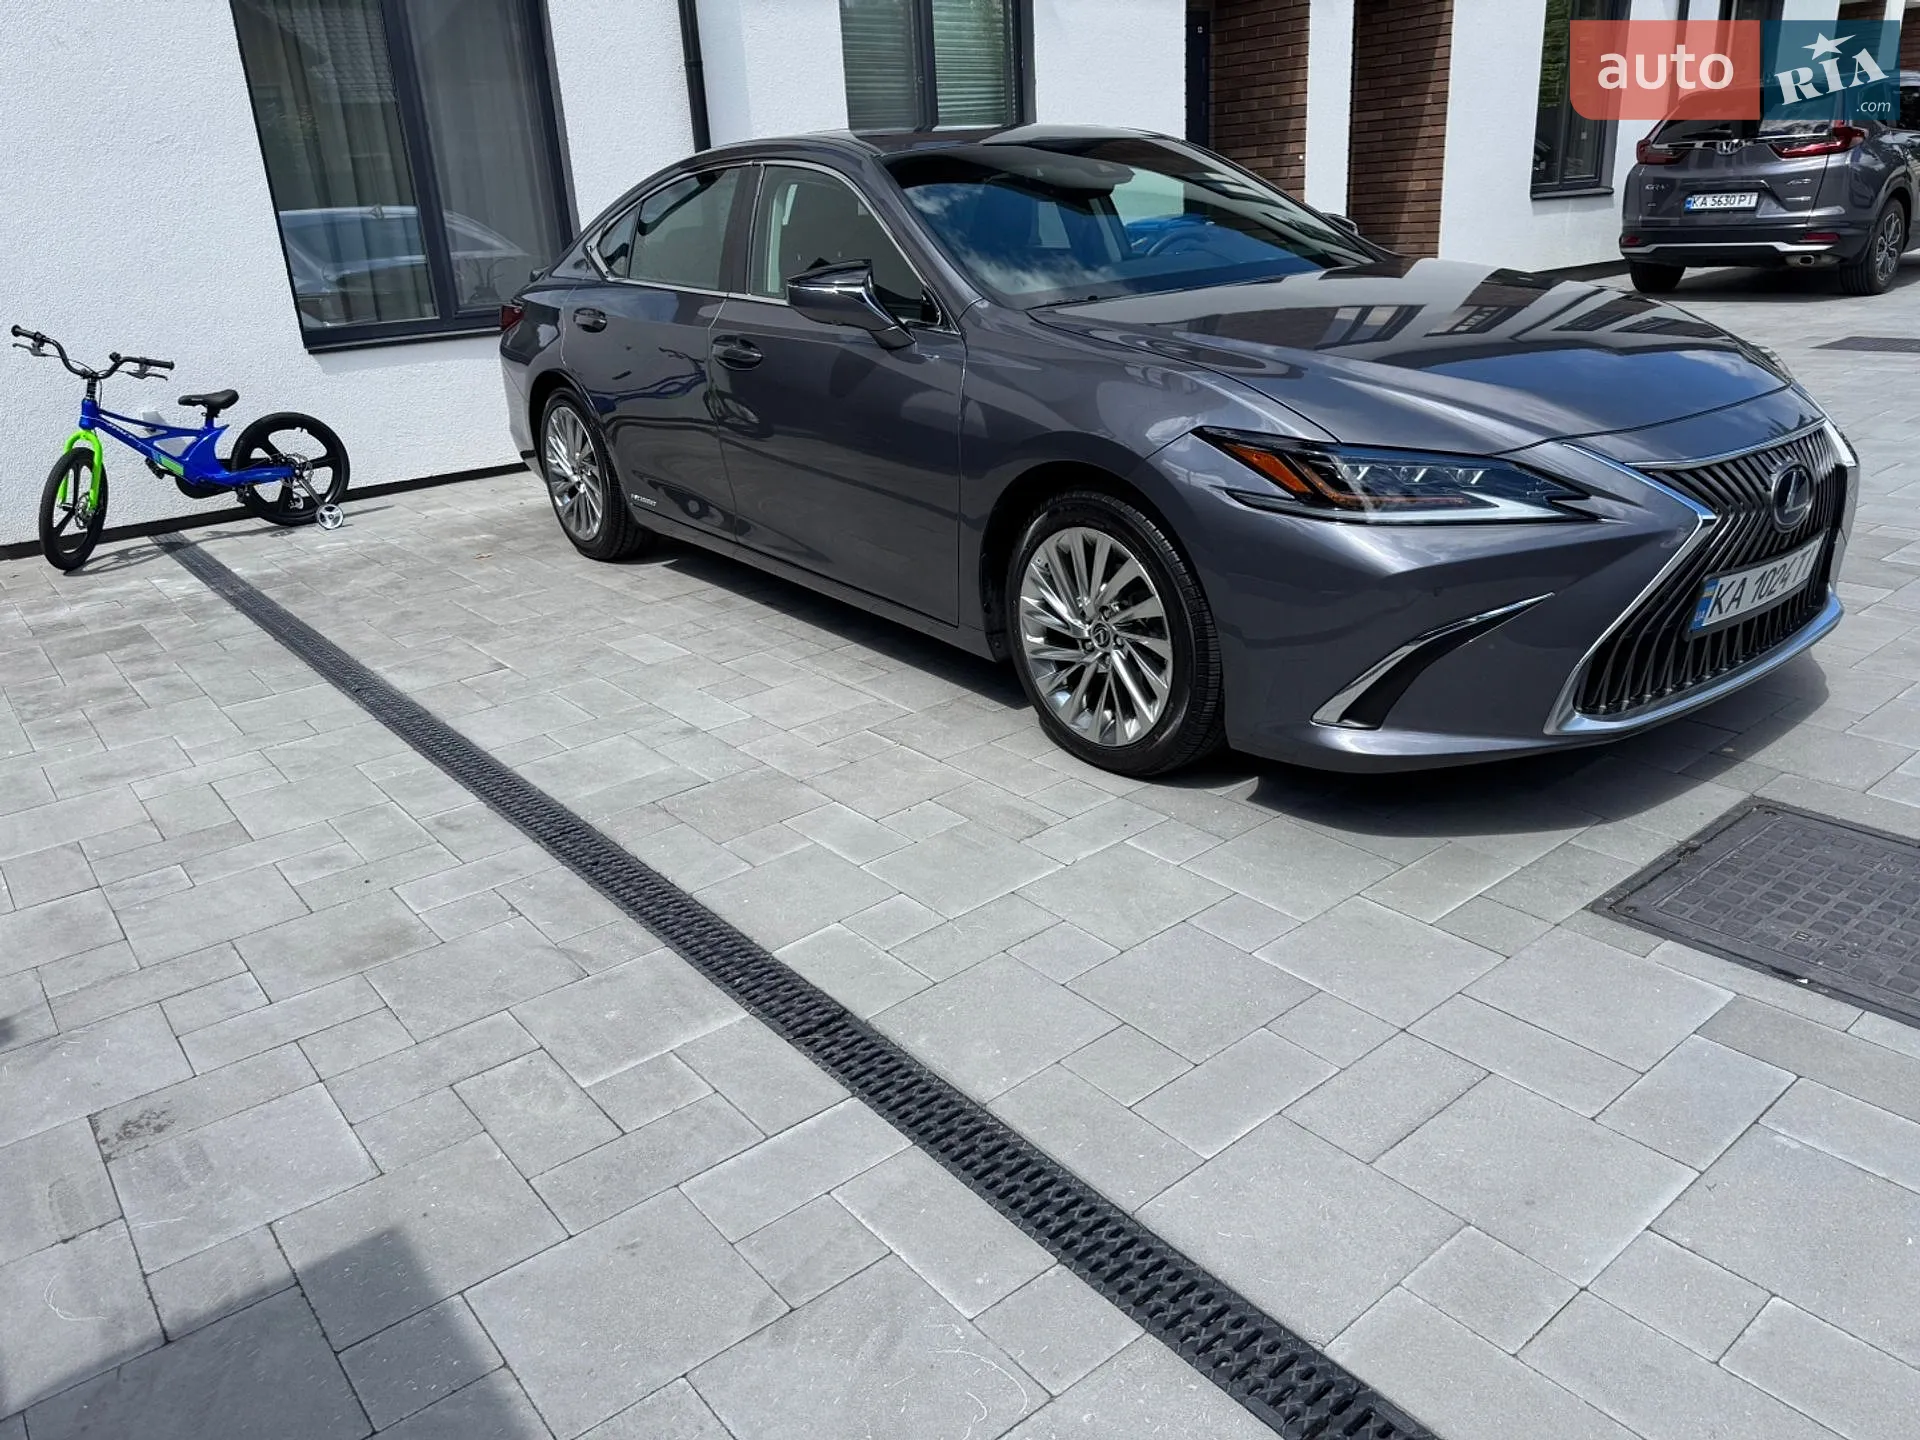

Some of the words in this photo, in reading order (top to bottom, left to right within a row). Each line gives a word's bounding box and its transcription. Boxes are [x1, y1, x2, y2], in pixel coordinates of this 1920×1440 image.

[1692, 195, 1707, 207] KA
[1710, 194, 1736, 207] 5630
[1707, 577, 1748, 618] KA
[1751, 556, 1798, 604] 1024
